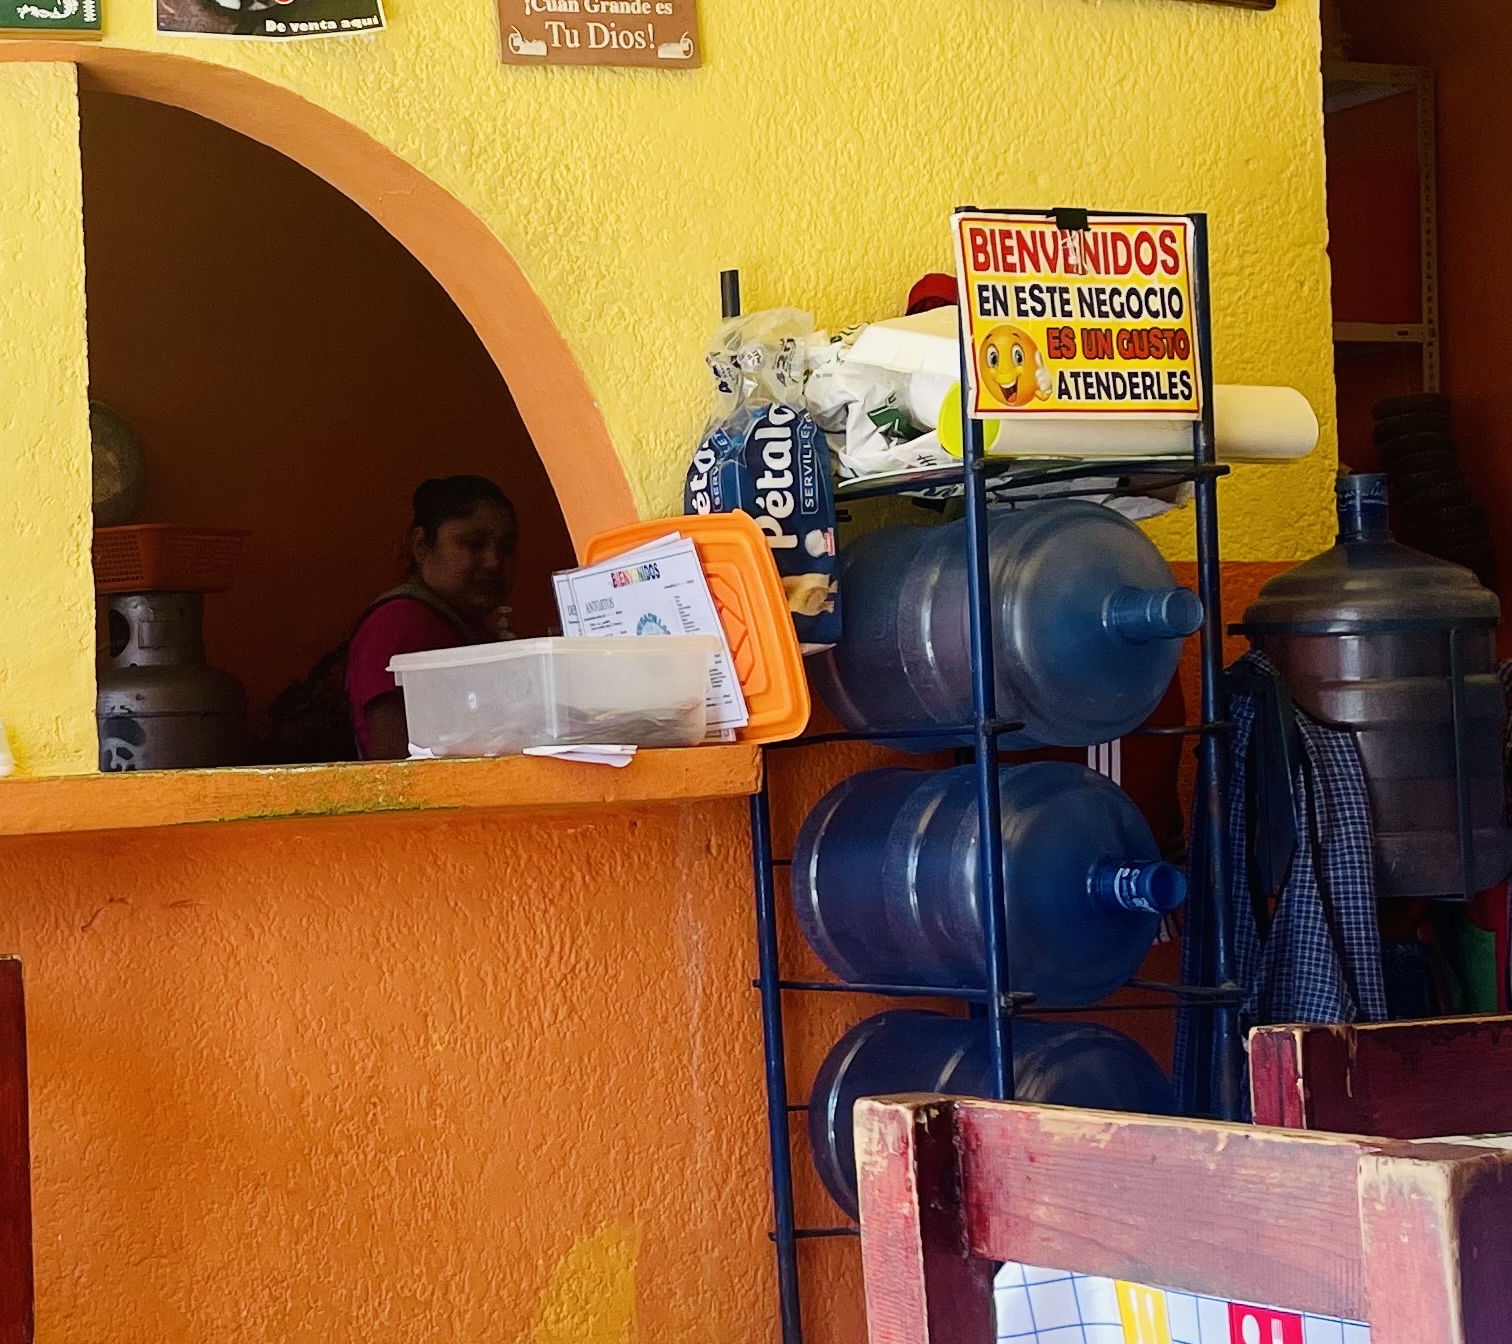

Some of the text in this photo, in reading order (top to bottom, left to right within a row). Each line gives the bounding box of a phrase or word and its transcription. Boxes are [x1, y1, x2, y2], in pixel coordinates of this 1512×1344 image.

[655, 2, 673, 15] es
[265, 20, 338, 33] De venta
[545, 21, 655, 49] Tu Dios!
[969, 227, 1180, 276] BIENVENIDOS
[977, 283, 1183, 319] EN ESTE NEGOCIO
[1046, 326, 1190, 360] ES UN GUSTO
[1058, 370, 1193, 401] ATENDERLES
